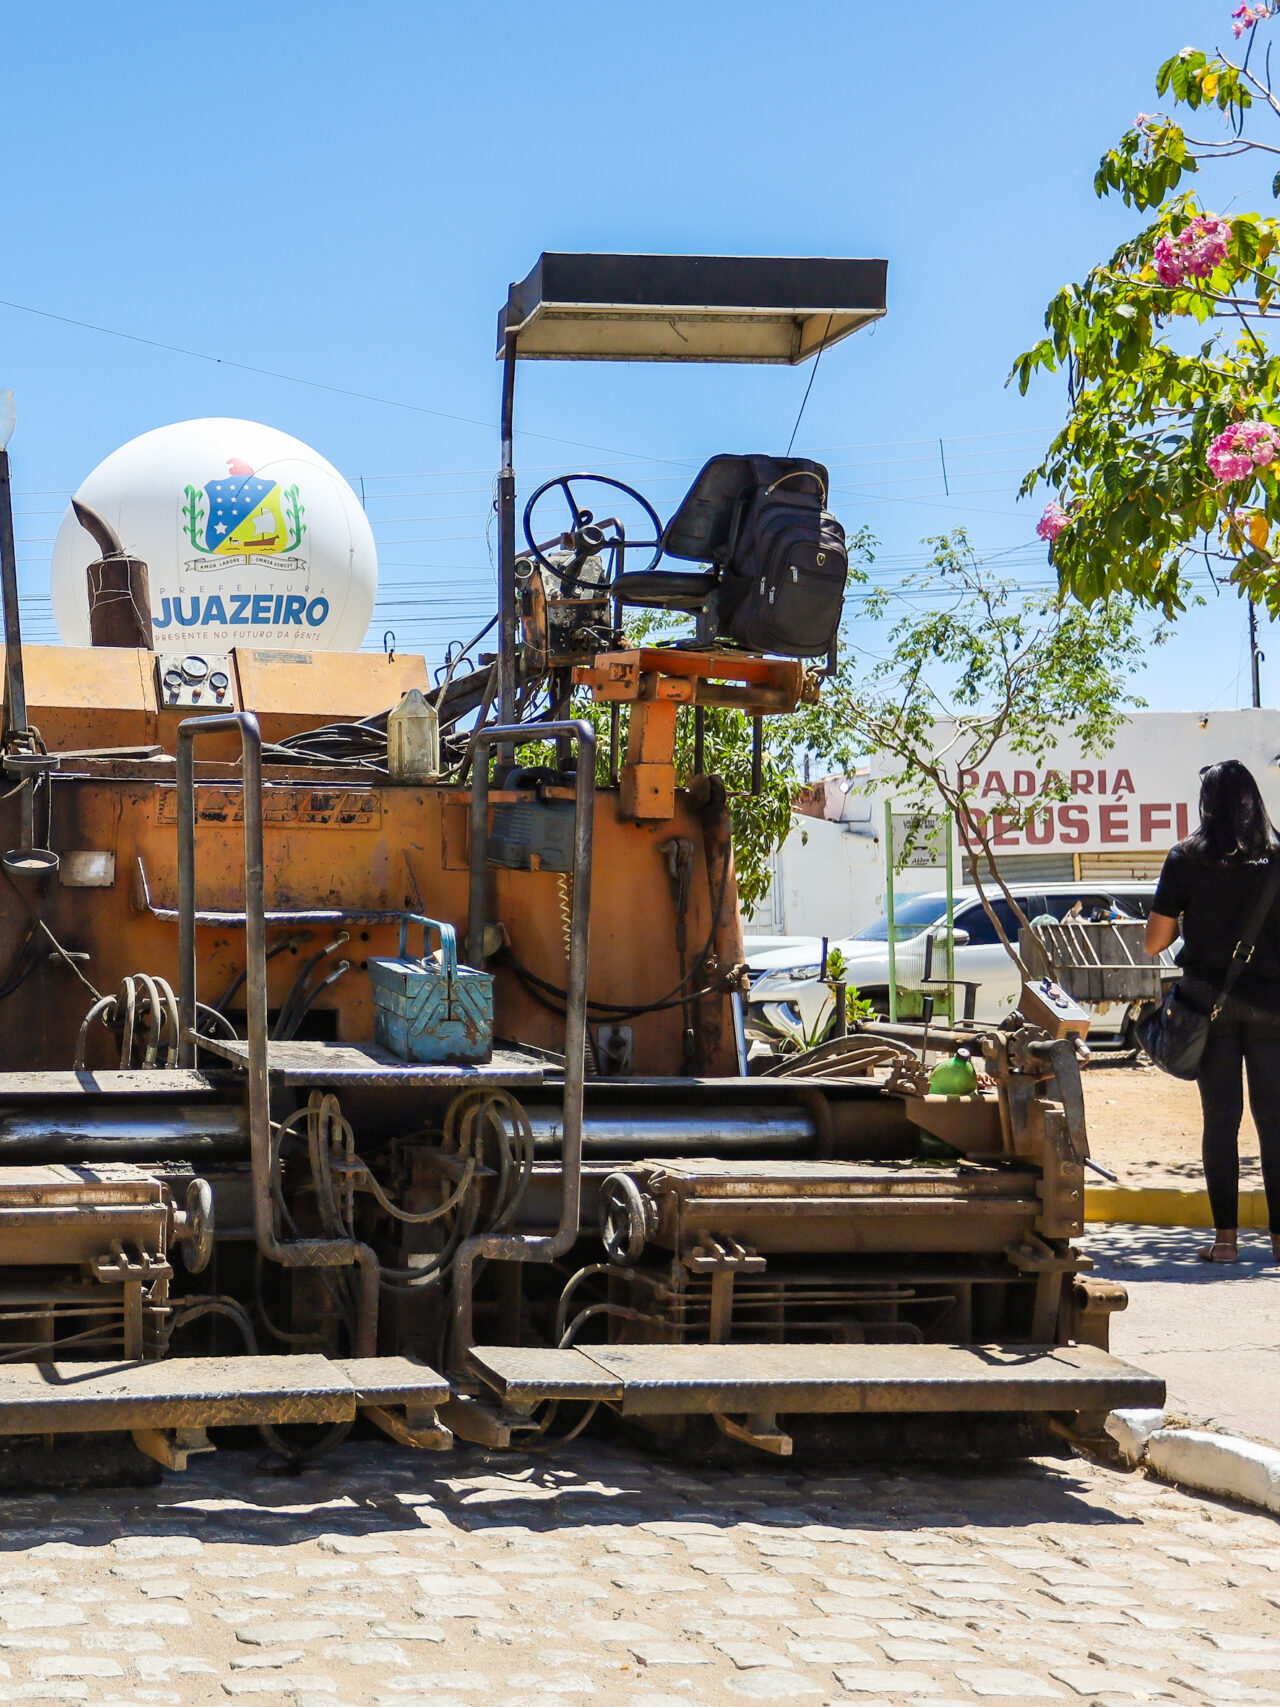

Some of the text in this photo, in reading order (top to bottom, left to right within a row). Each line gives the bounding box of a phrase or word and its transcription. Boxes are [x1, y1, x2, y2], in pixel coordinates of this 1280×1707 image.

[255, 557, 273, 566] OMNIA
[160, 584, 326, 595] PREFEITURA
[152, 595, 330, 629] JUAZEIRO
[155, 632, 209, 641] PRESENTE
[233, 630, 273, 639] FUTURO
[277, 631, 290, 639] DA
[294, 631, 322, 641] GENTE
[957, 769, 1136, 798] PADARIA
[958, 794, 1189, 846] DEUS É FI
